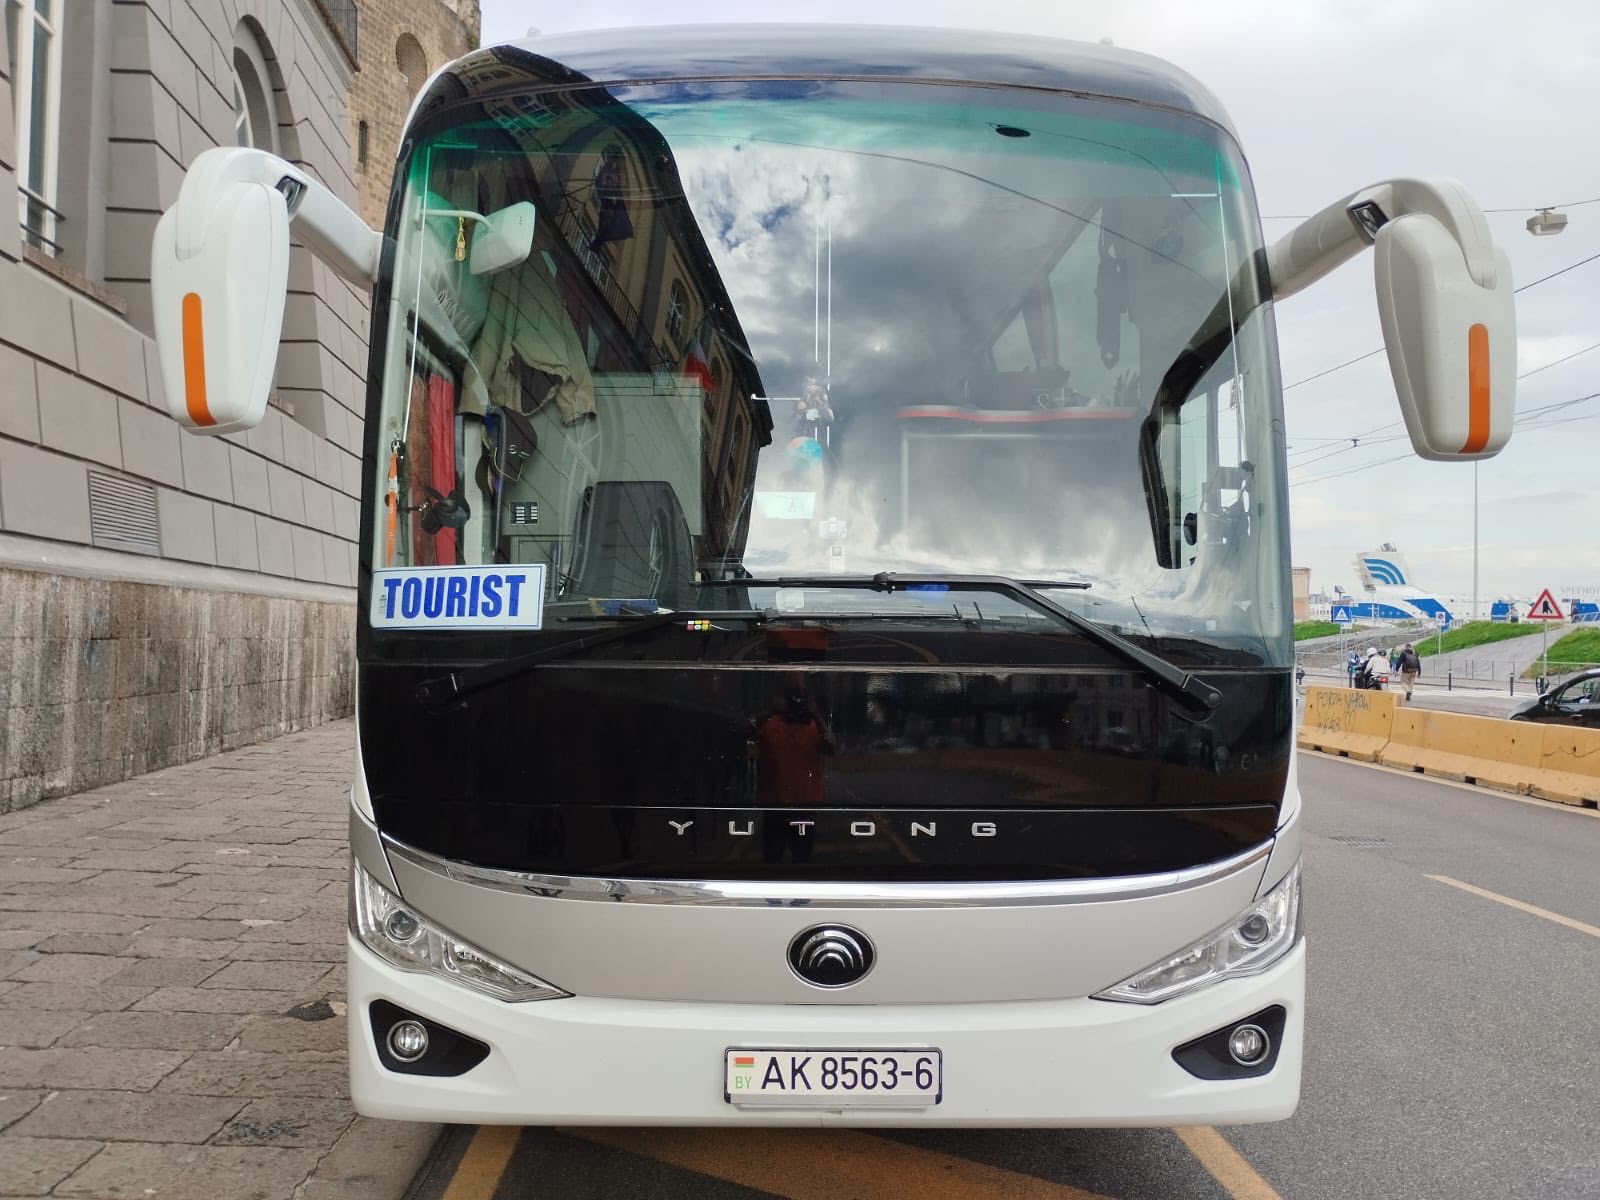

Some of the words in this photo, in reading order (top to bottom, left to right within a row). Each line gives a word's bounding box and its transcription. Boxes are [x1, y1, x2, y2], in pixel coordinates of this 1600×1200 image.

[384, 574, 526, 619] TOURIST
[668, 820, 997, 837] YUTONG
[735, 1076, 753, 1089] BY
[761, 1056, 812, 1090] AK
[821, 1056, 933, 1090] 8563-6
